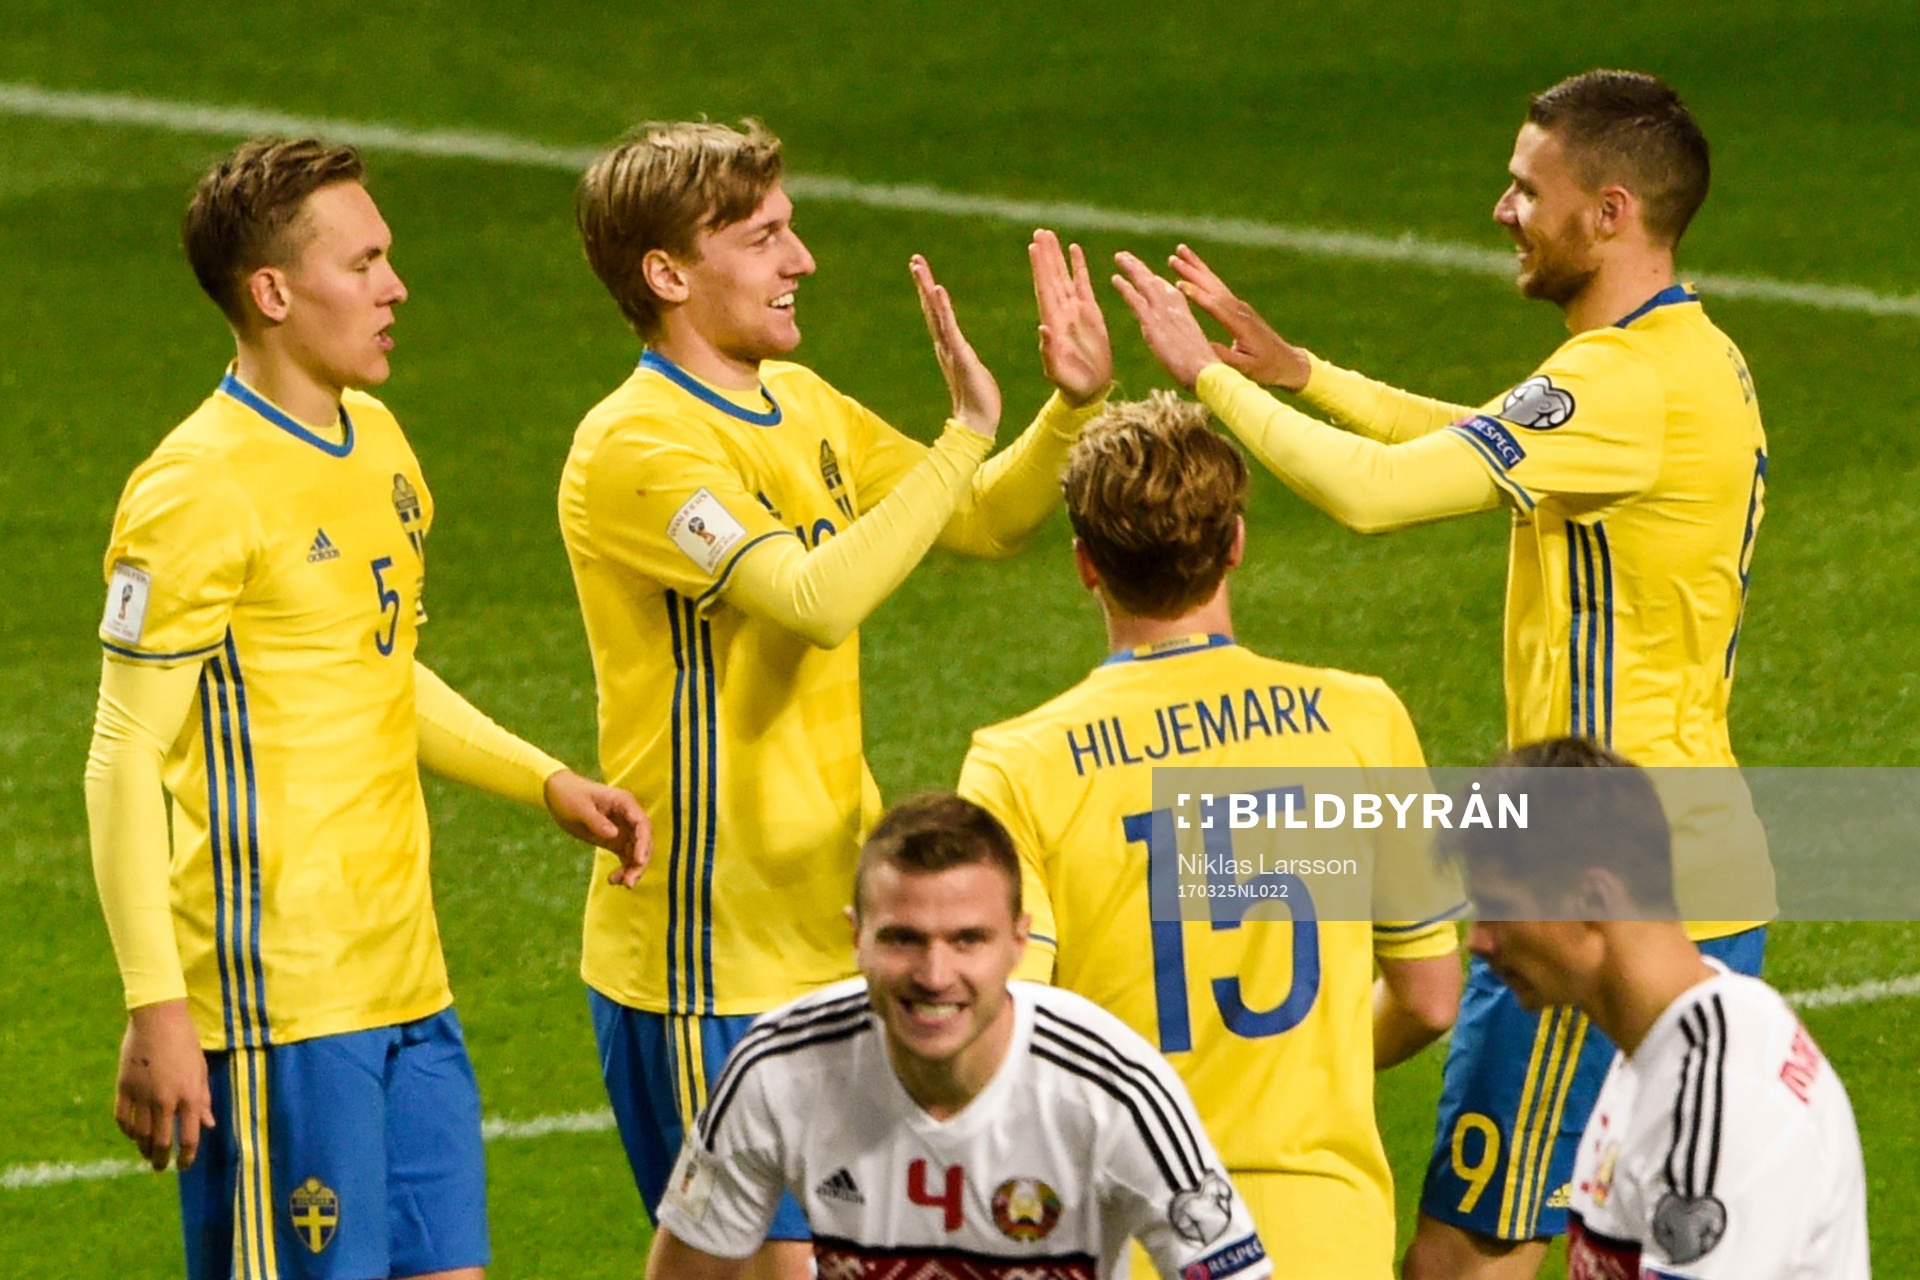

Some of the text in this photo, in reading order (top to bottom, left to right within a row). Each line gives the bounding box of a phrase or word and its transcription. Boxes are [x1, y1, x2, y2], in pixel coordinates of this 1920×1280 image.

[1470, 418, 1521, 465] RESPECT
[370, 555, 400, 657] 5
[1066, 685, 1331, 776] HILJEMARK
[1122, 784, 1321, 1054] 15
[907, 1158, 964, 1233] 4
[1452, 1112, 1500, 1214] 9
[1207, 1239, 1262, 1274] RESPEC
